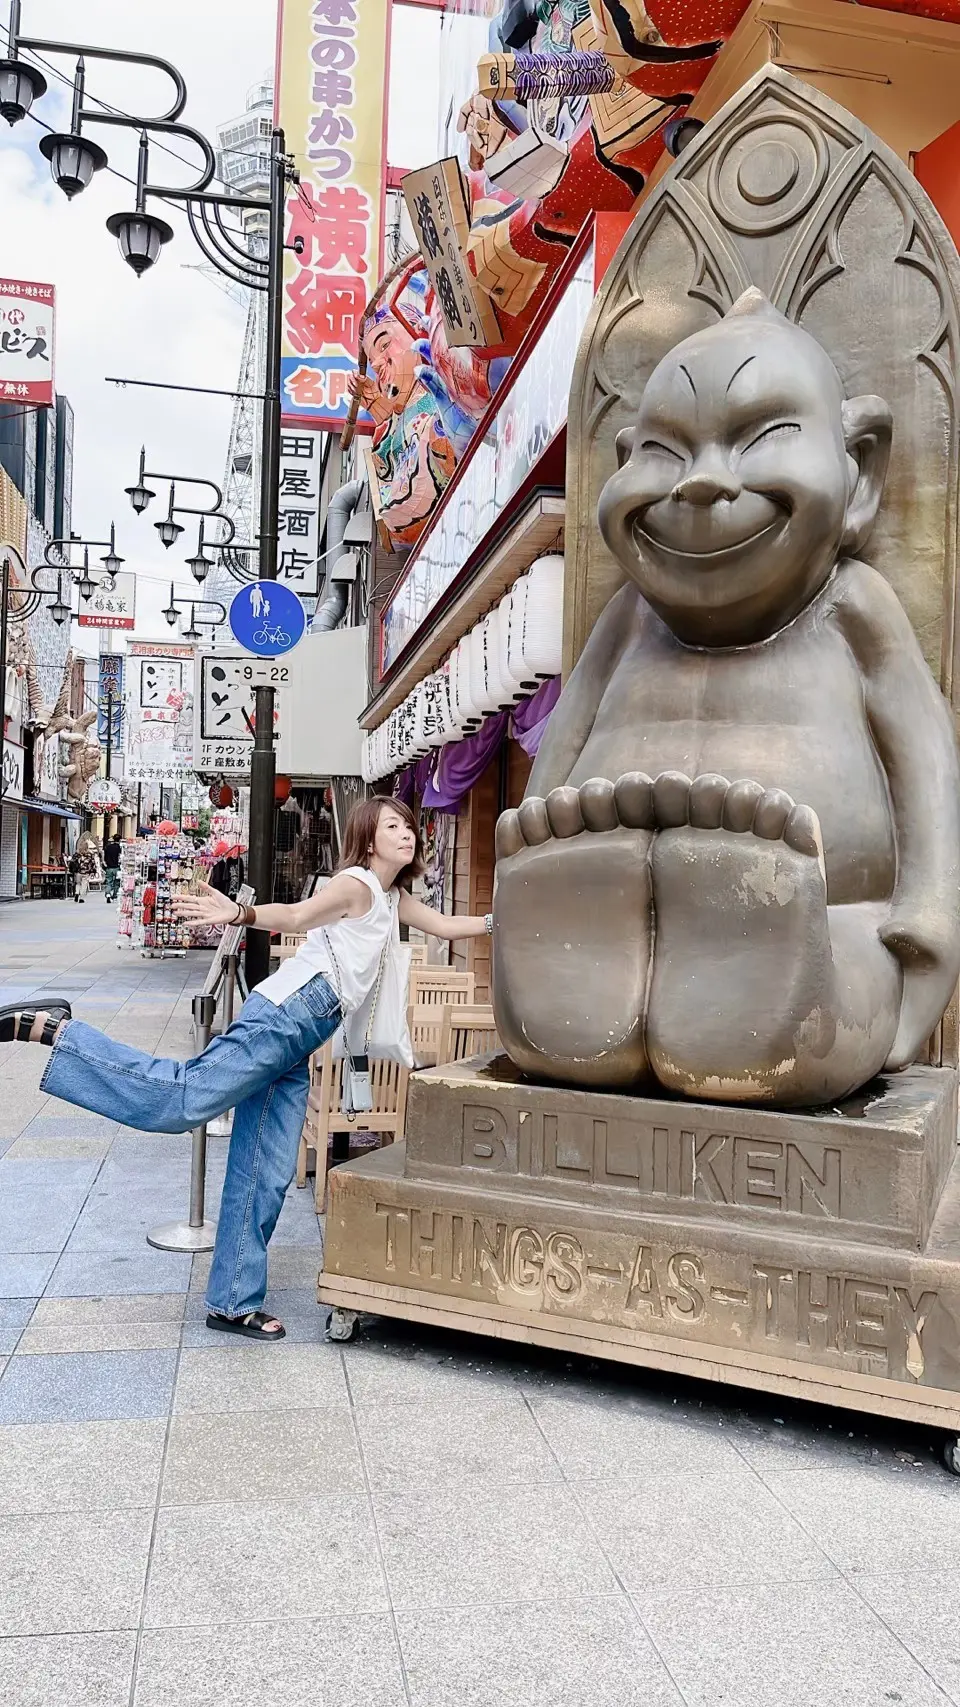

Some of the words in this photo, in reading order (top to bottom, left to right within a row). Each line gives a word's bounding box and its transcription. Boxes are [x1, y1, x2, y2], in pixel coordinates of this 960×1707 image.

[0, 282, 52, 298] み焼き・焼きそば
[0, 328, 49, 361] ビス
[0, 383, 29, 396] 無休
[423, 690, 437, 737] サーモン
[202, 744, 212, 753] 1F
[201, 757, 212, 766] 2F
[461, 1103, 842, 1220] BILLIKEN
